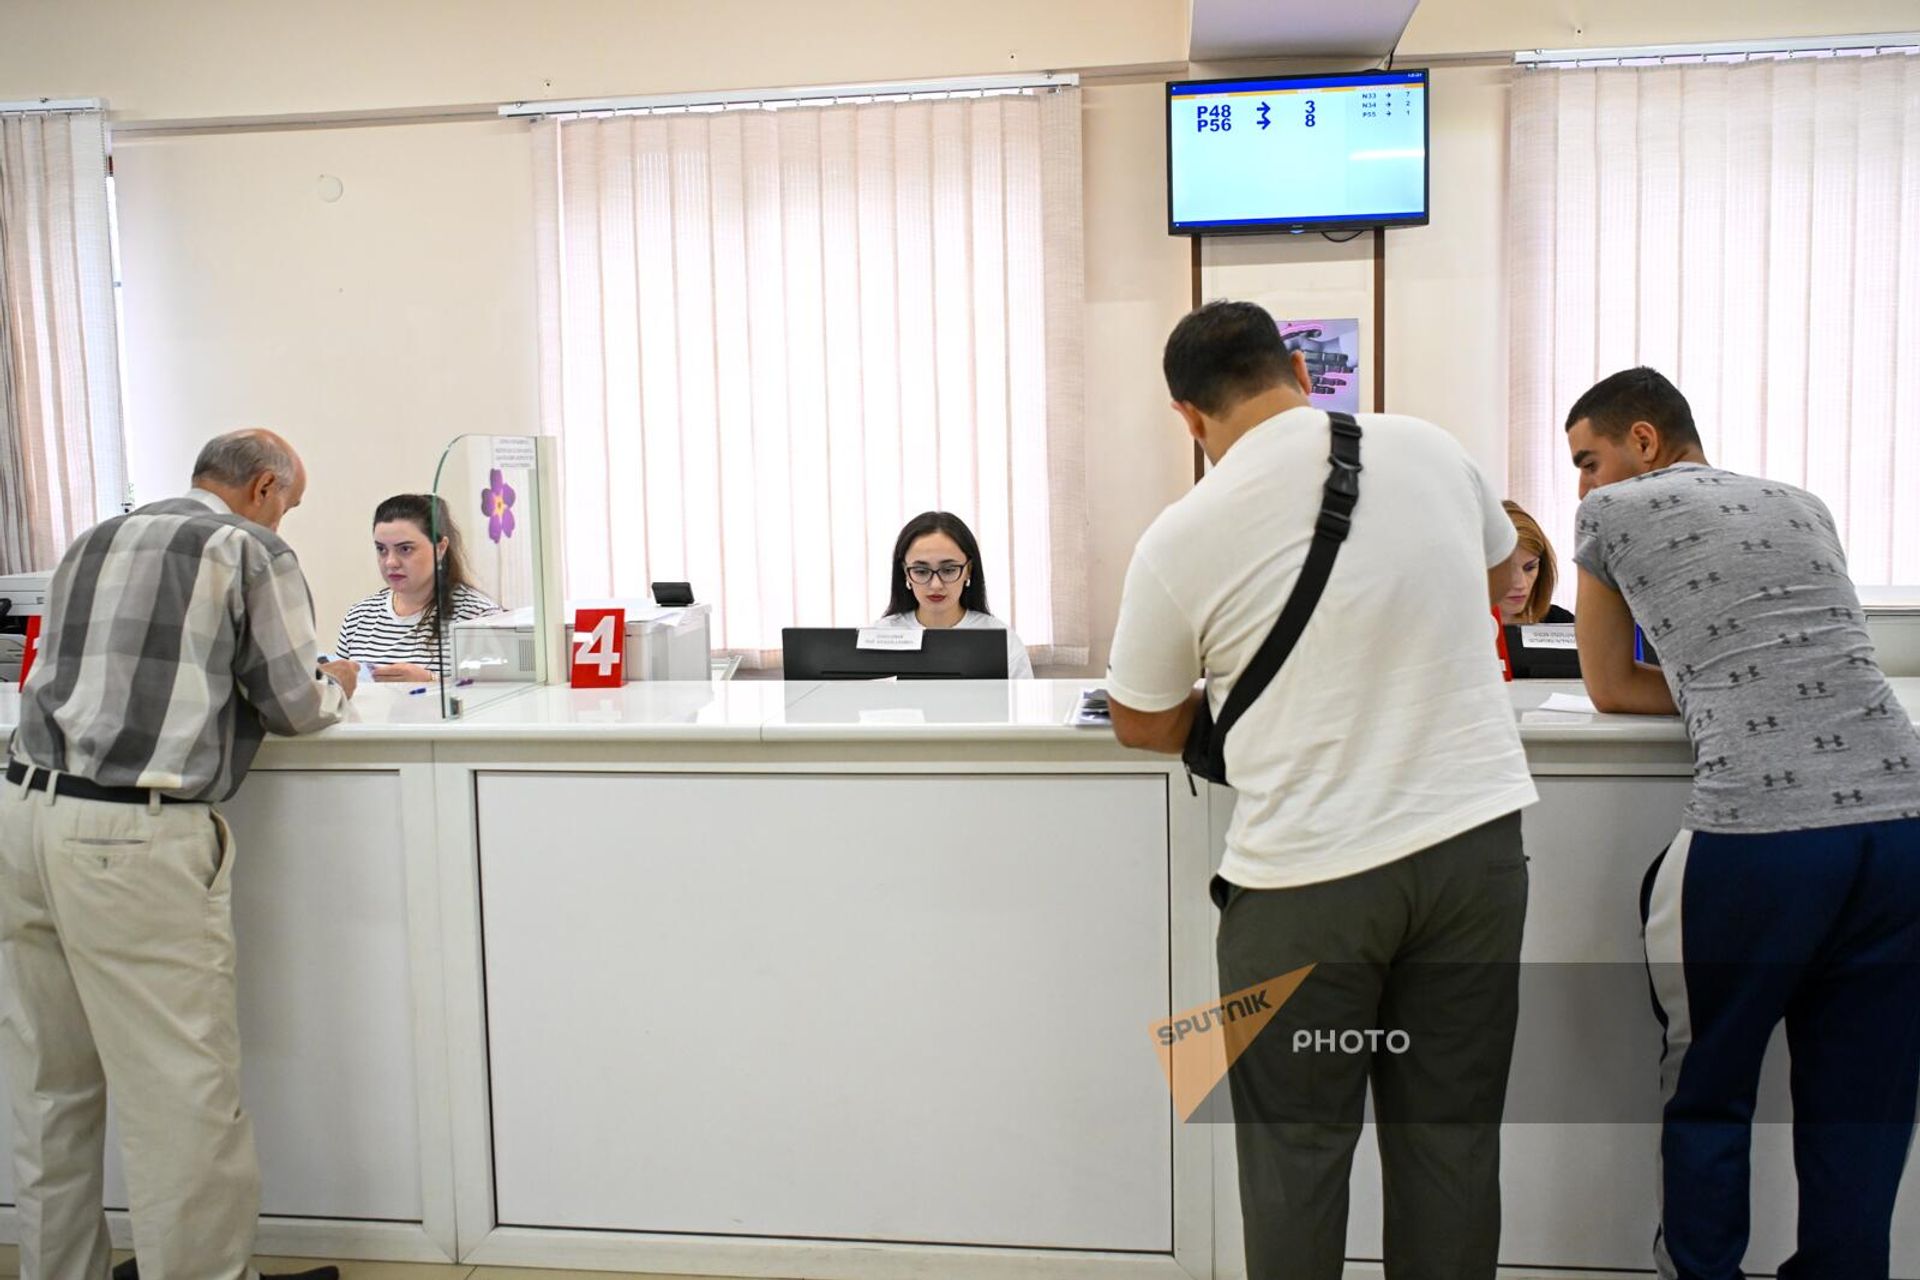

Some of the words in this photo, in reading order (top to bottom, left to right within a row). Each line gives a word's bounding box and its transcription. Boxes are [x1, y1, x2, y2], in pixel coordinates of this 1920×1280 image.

[1197, 104, 1232, 119] P48
[1305, 100, 1316, 113] 3
[1197, 118, 1232, 132] P56
[1305, 114, 1316, 127] 8
[575, 615, 621, 676] 4
